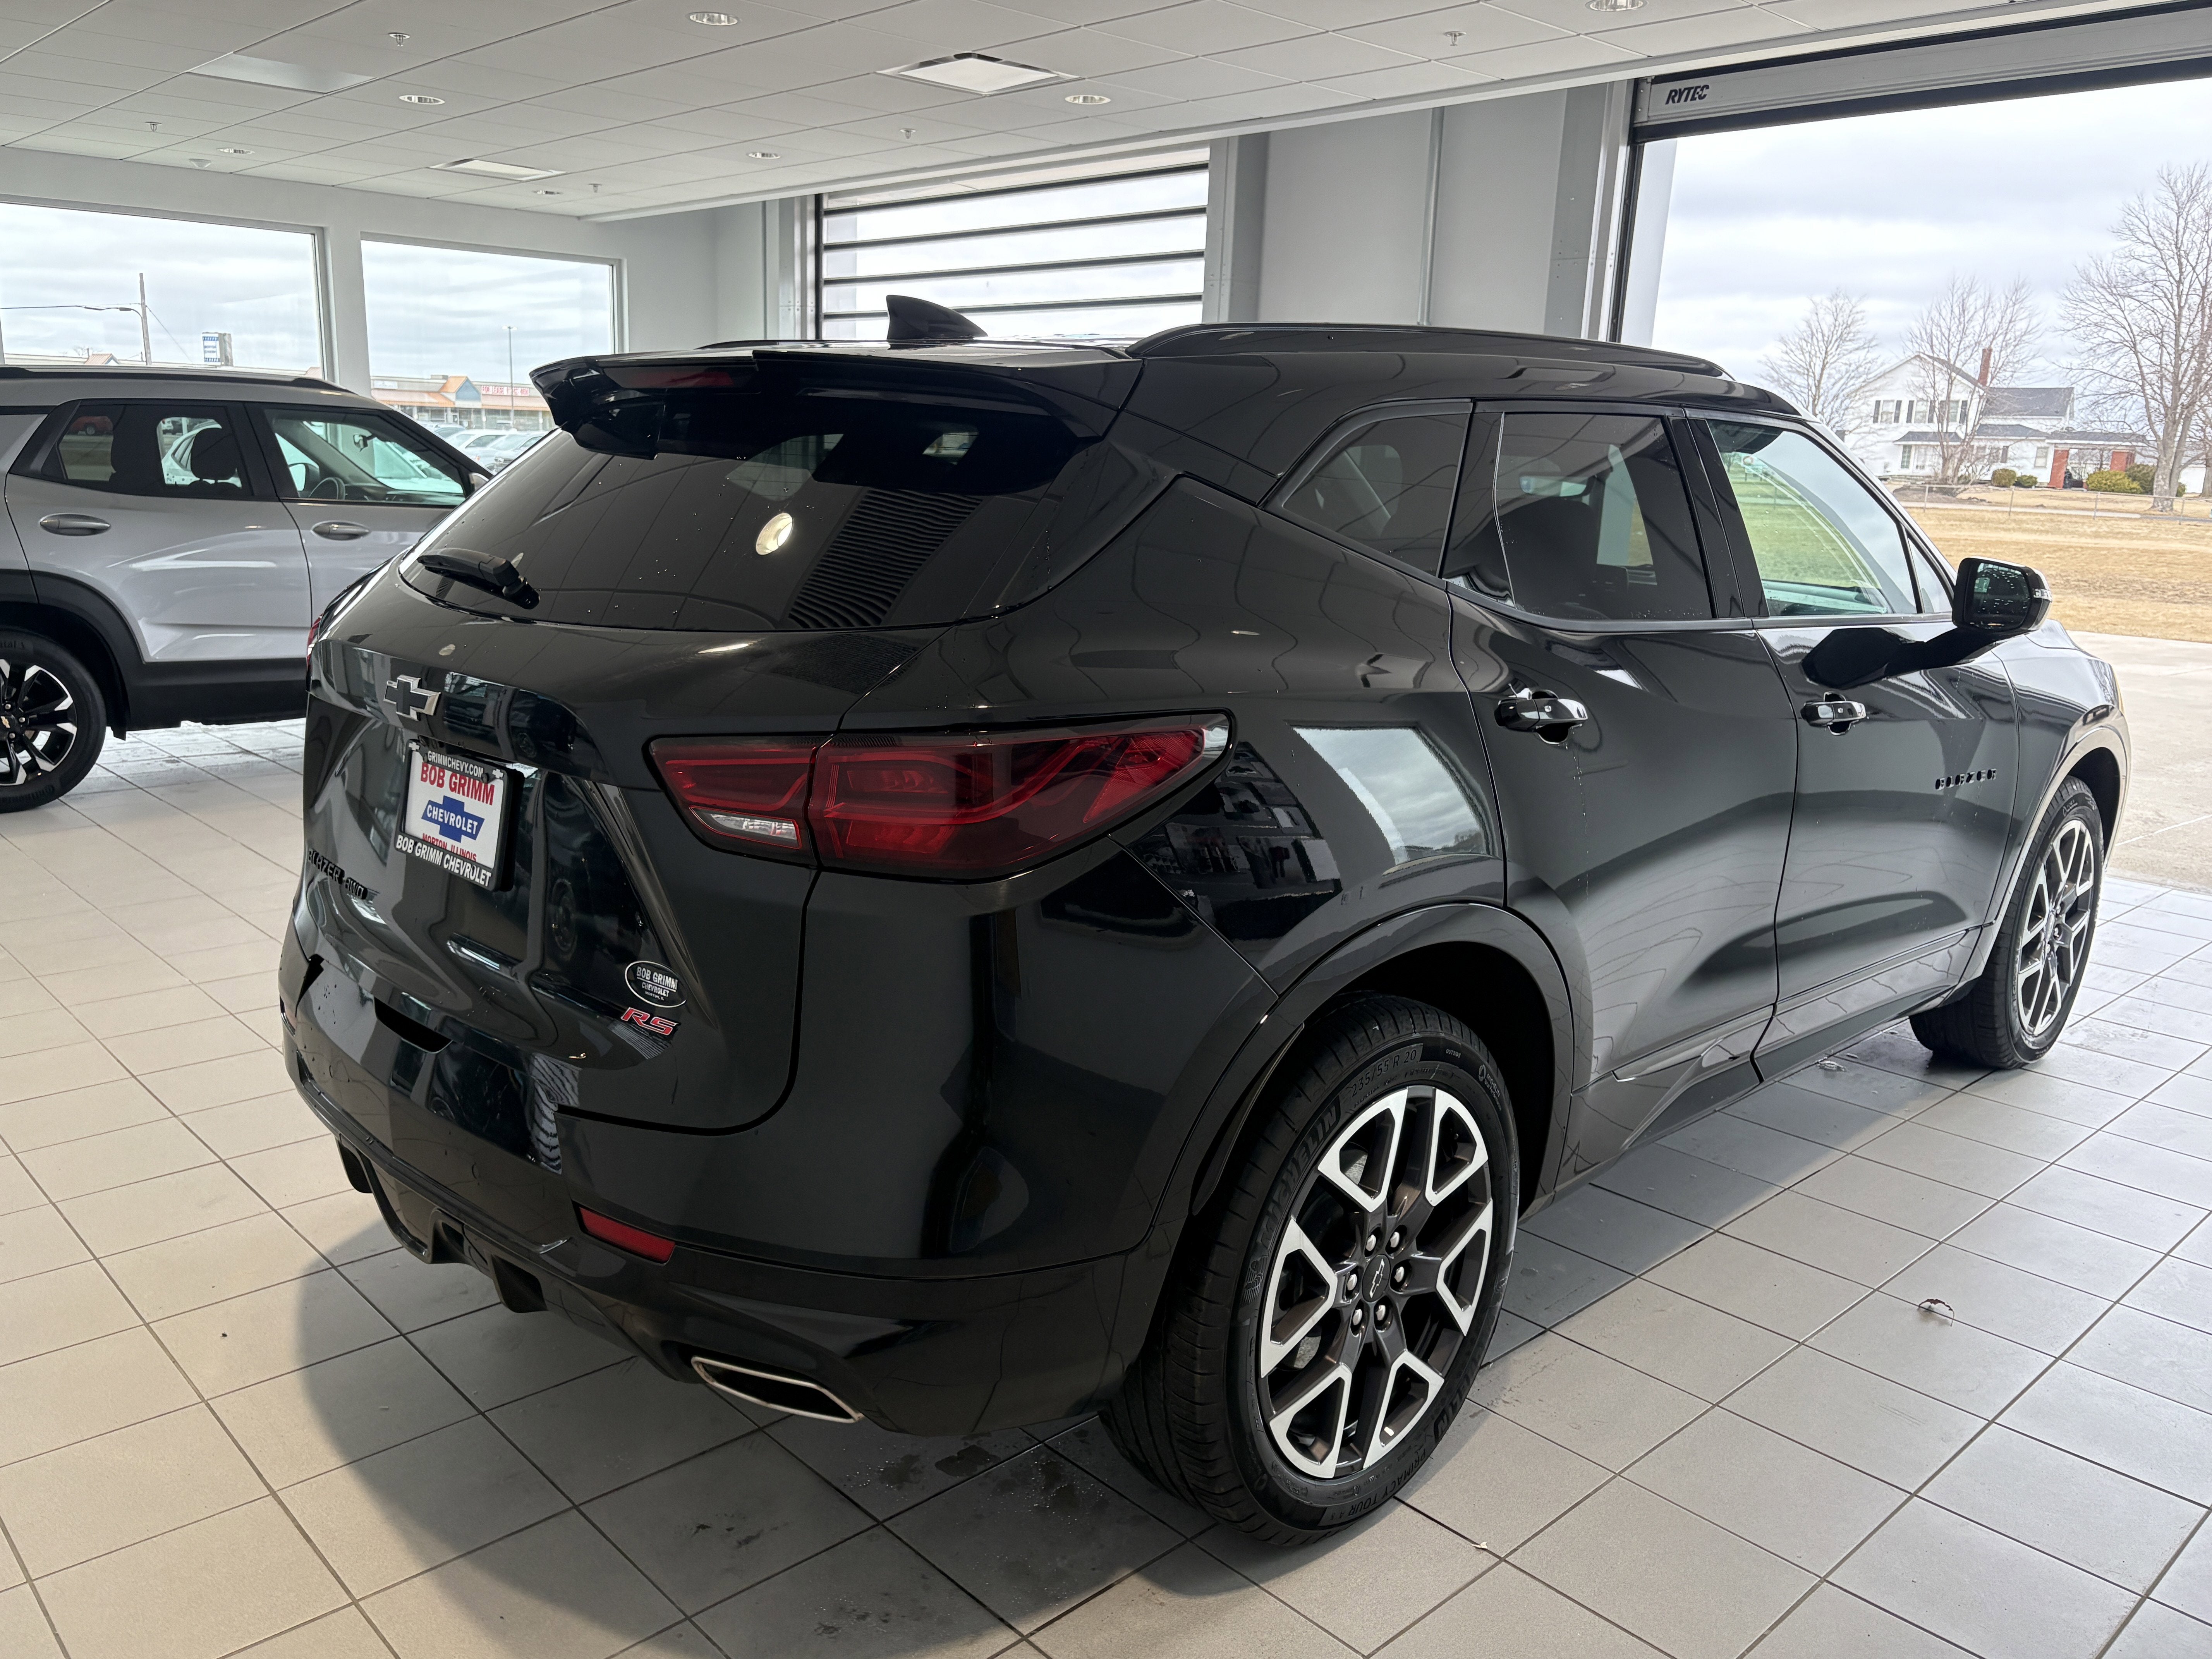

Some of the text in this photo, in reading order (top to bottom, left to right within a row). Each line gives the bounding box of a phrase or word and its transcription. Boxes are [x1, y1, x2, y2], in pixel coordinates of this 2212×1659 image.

[1665, 84, 1709, 105] RYTEC
[427, 750, 484, 778] GRIMMCHEVY.COM
[421, 762, 495, 806] BOB GRIMM
[1935, 769, 1997, 791] BLAZER
[427, 804, 478, 835] CHEVROLET
[396, 835, 492, 887] BOB GRIMM CHEVROLET
[636, 966, 678, 990] BOB GRIMM
[642, 982, 670, 998] CHEVROLET
[620, 1006, 679, 1036] RS
[1352, 1059, 1389, 1097] 235/55
[1393, 1047, 1400, 1068] R
[1403, 1049, 1417, 1063] 20
[1255, 1105, 1337, 1250] MICHELIN
[1382, 1448, 1426, 1499] PRIMACY
[1347, 1493, 1377, 1516] TOUR
